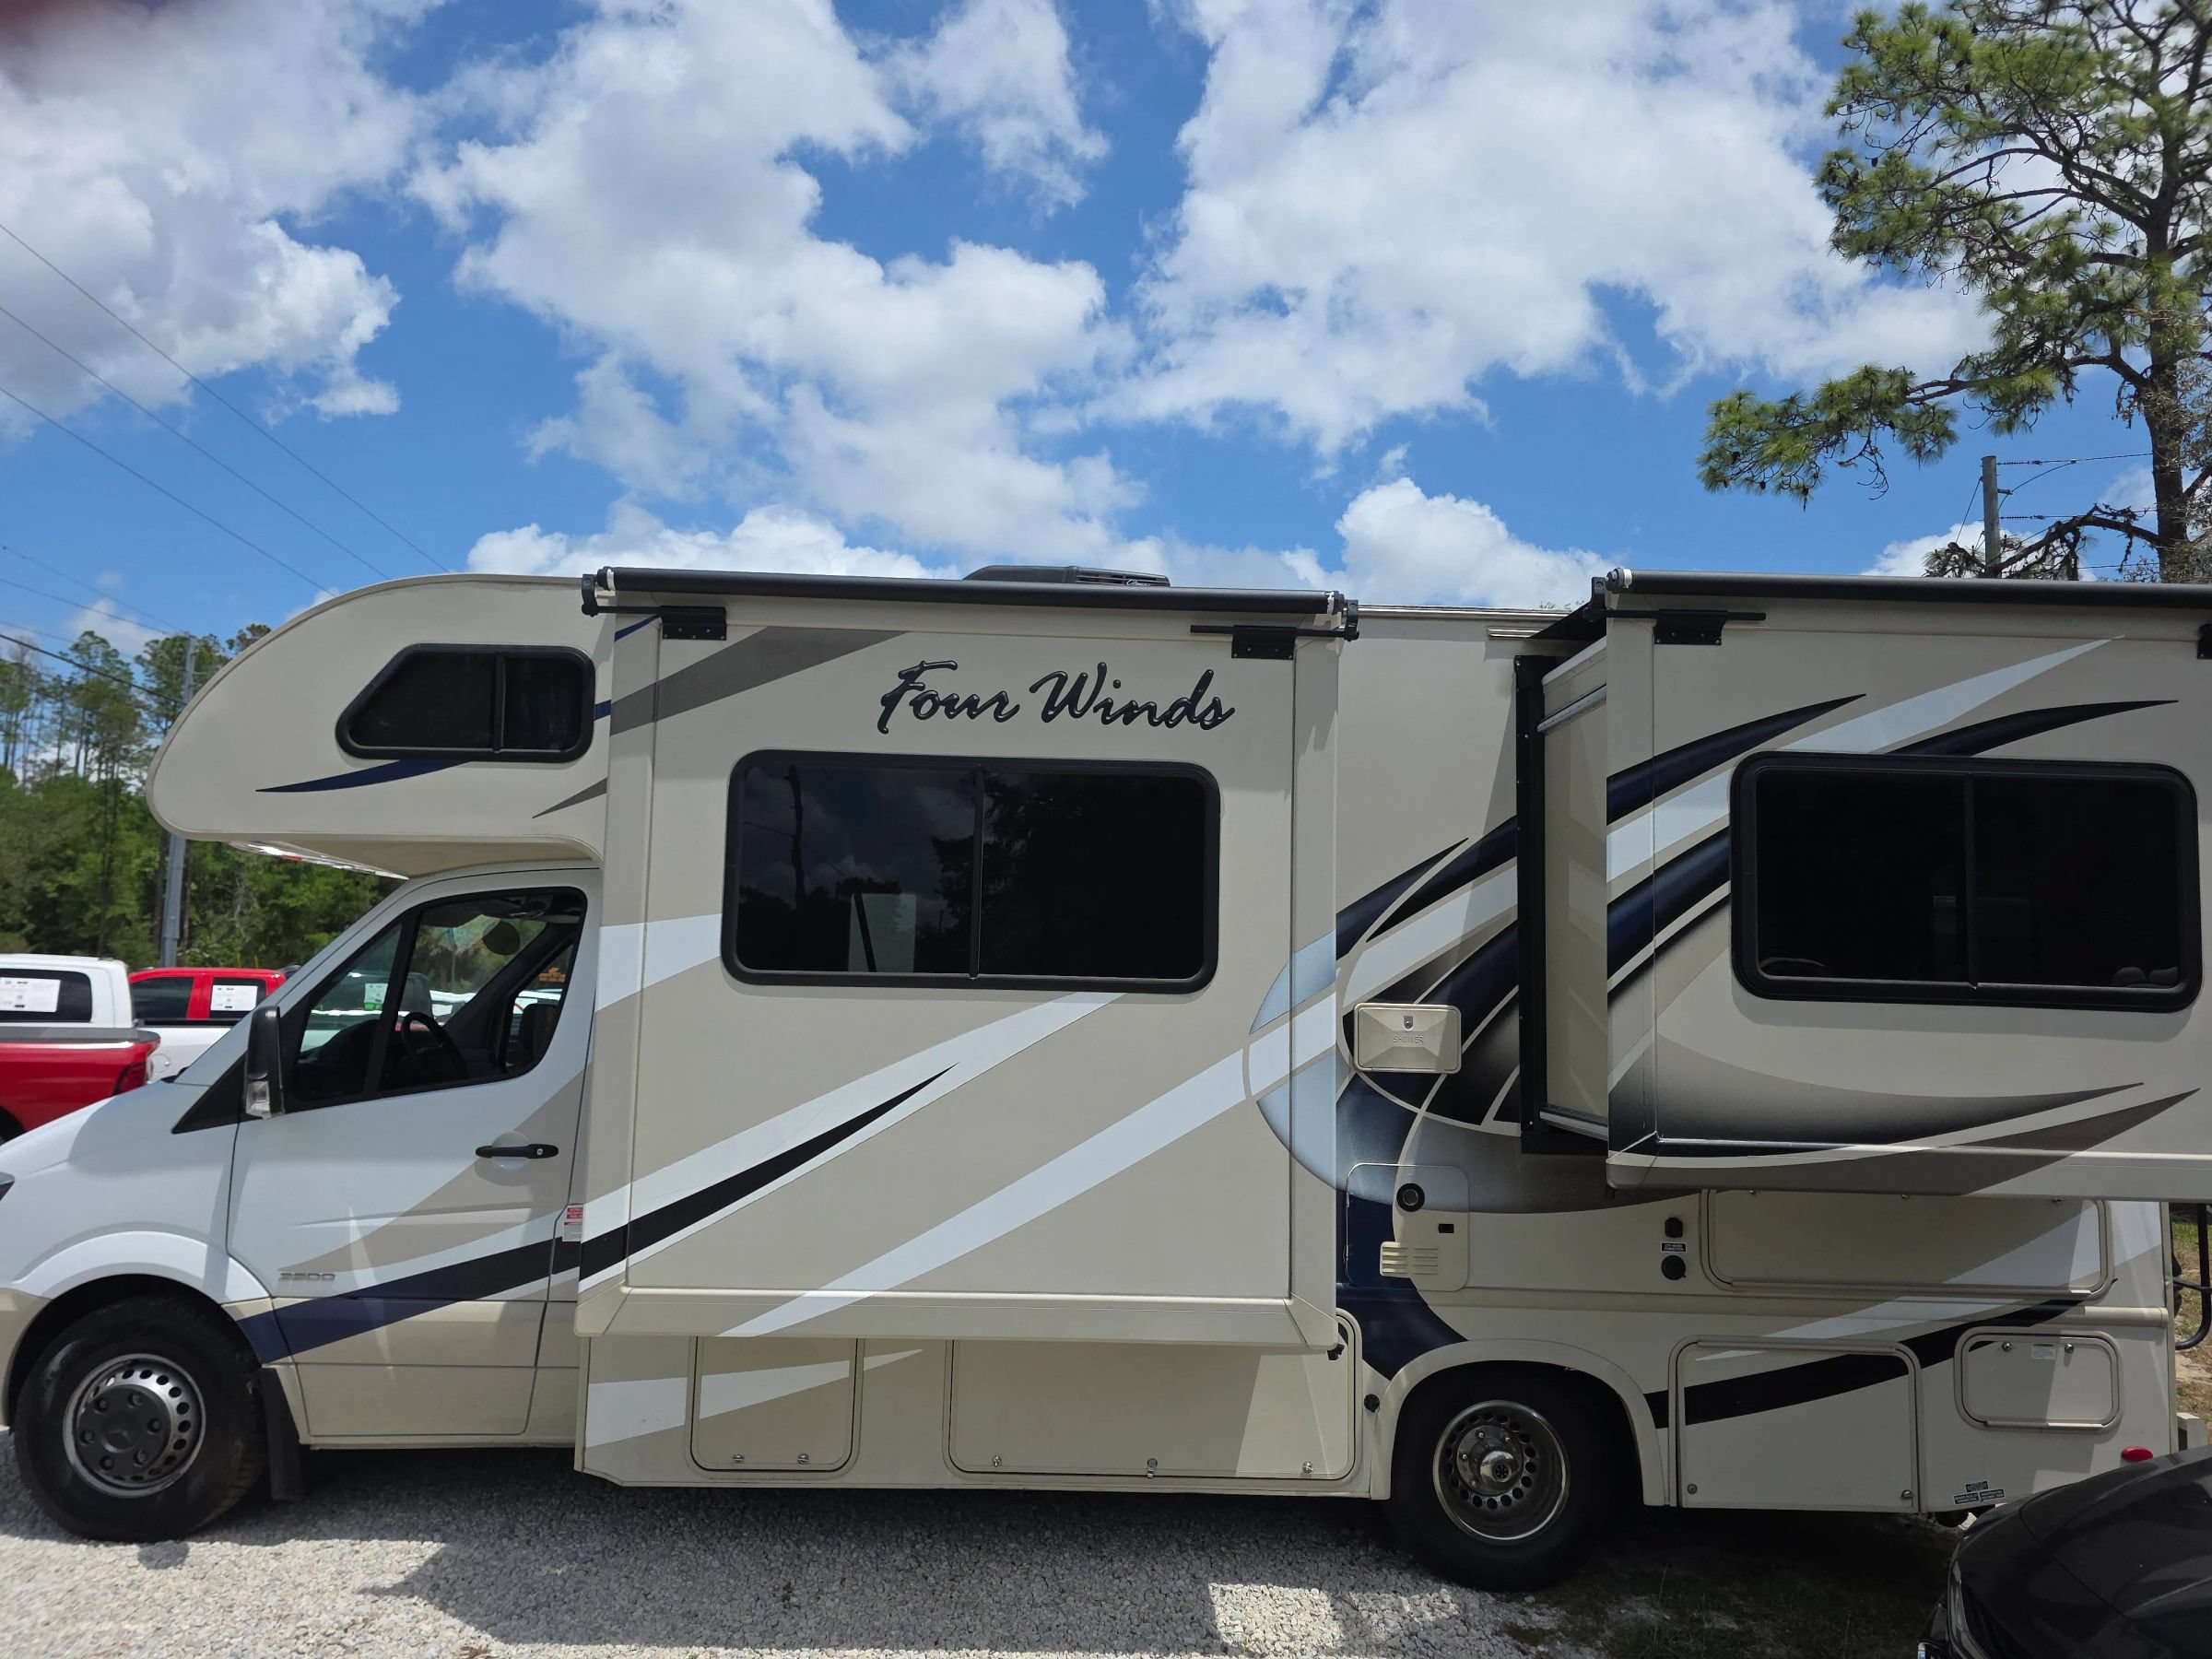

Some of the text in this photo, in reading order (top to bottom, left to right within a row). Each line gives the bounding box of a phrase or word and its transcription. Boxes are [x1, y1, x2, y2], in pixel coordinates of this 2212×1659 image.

[877, 660, 1236, 735] Four Winds
[1393, 1035, 1424, 1044] SHOWER
